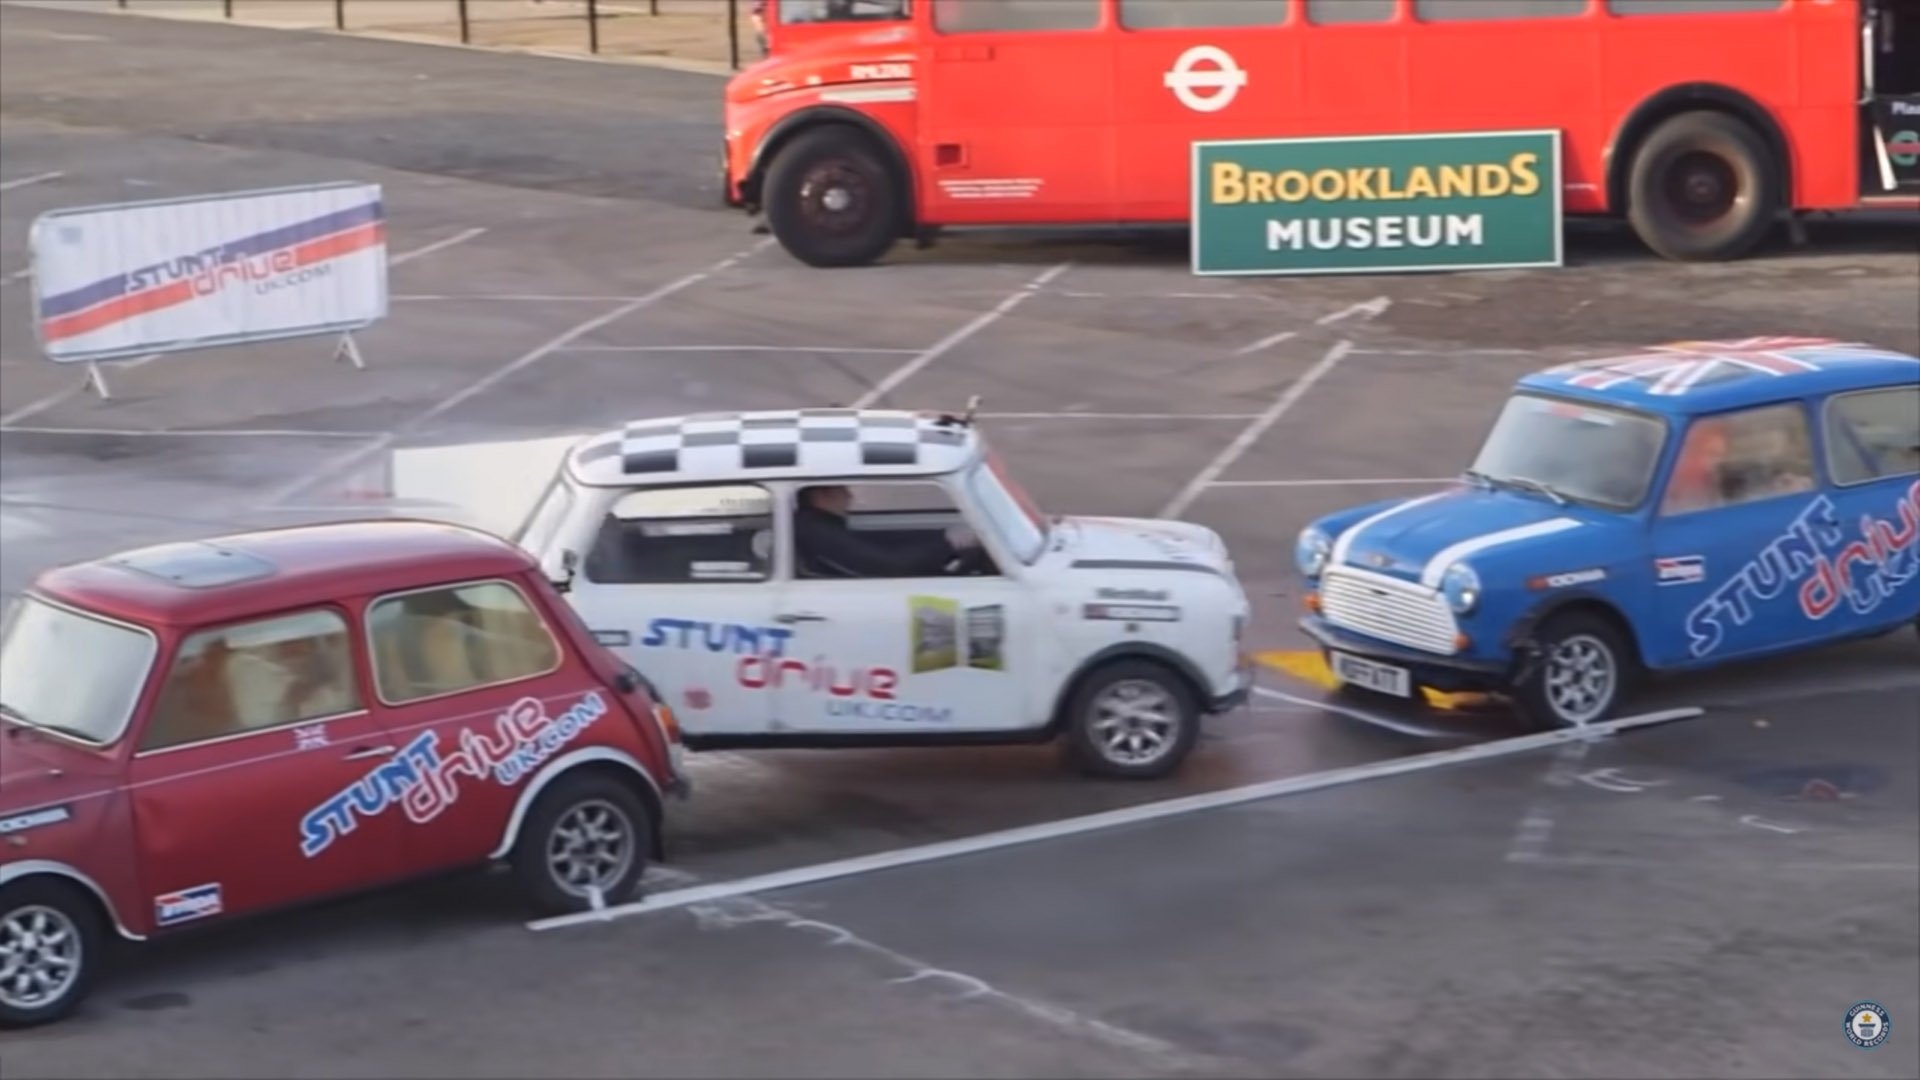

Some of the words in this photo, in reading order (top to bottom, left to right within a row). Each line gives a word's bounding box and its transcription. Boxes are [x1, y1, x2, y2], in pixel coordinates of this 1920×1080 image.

[1211, 152, 1540, 204] BROOKLANDS
[1266, 213, 1484, 251] MUSEUM
[127, 247, 223, 292] STUNT
[193, 249, 298, 297] drive
[1686, 494, 1843, 657] STUNT
[1800, 480, 1920, 620] driv
[642, 618, 793, 657] STUNT
[736, 645, 899, 700] drive
[402, 696, 552, 824] drive
[300, 729, 439, 858] STUNT
